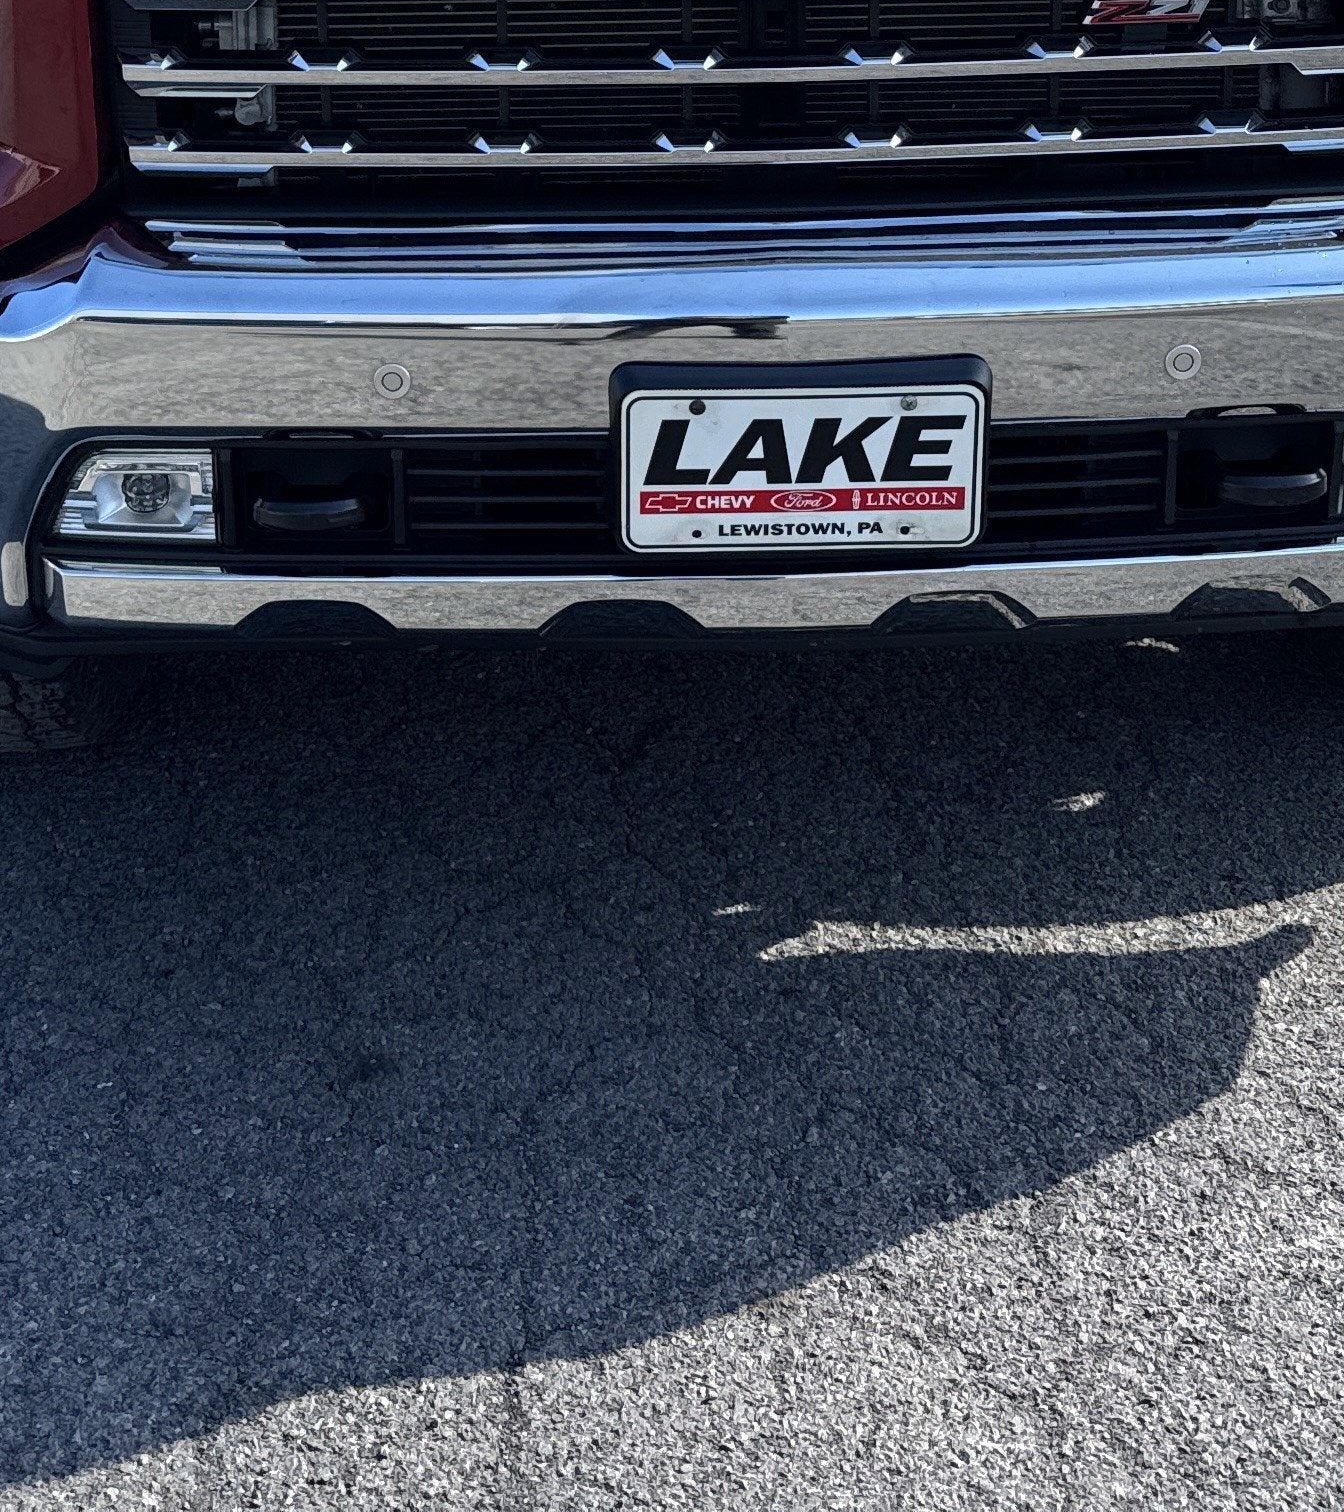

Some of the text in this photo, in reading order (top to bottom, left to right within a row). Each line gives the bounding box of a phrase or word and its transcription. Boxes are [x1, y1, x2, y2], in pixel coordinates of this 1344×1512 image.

[643, 414, 968, 486] LAKE
[695, 495, 756, 510] CHEVY
[783, 492, 823, 509] Ford
[865, 491, 958, 507] LINCOLN
[718, 522, 884, 538] LEWISTOWN, PA
